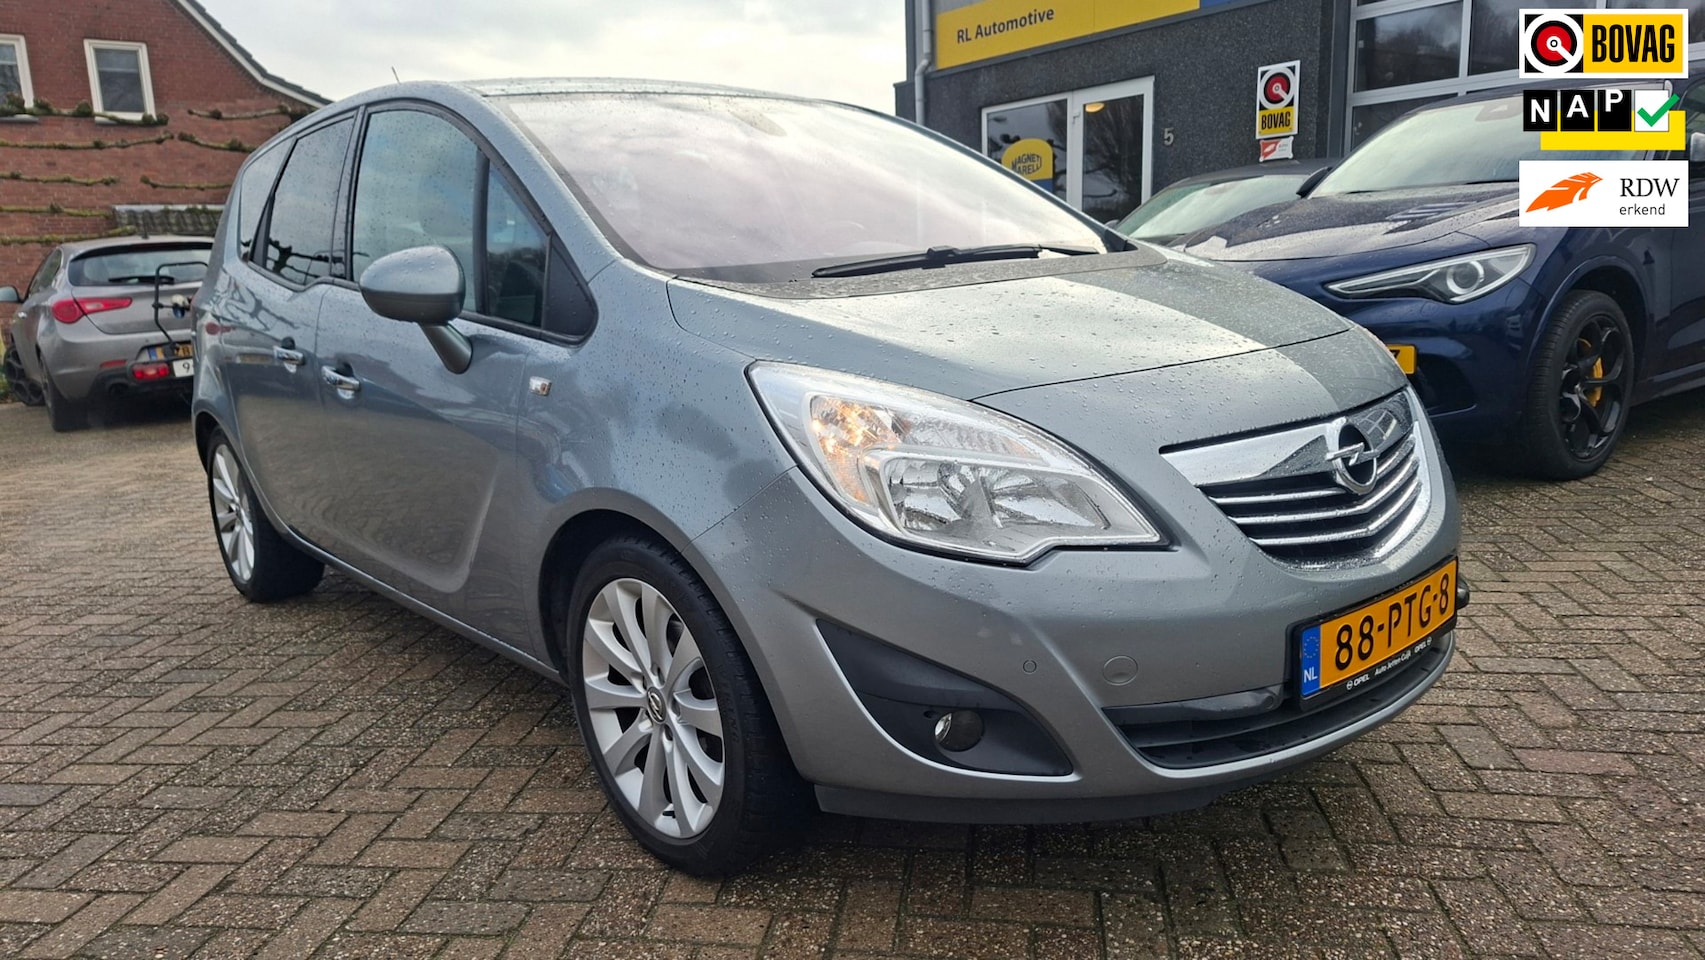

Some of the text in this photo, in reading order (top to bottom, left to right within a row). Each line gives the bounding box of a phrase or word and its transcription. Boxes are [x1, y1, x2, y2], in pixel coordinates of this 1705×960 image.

[956, 8, 1054, 44] RL Automotive
[1261, 111, 1291, 131] BOVAG
[1164, 127, 1174, 146] 5
[1334, 572, 1450, 671] 88-PTG-8
[1303, 667, 1318, 684] NL
[1353, 673, 1370, 686] OPEL
[1414, 641, 1427, 654] OPEL
